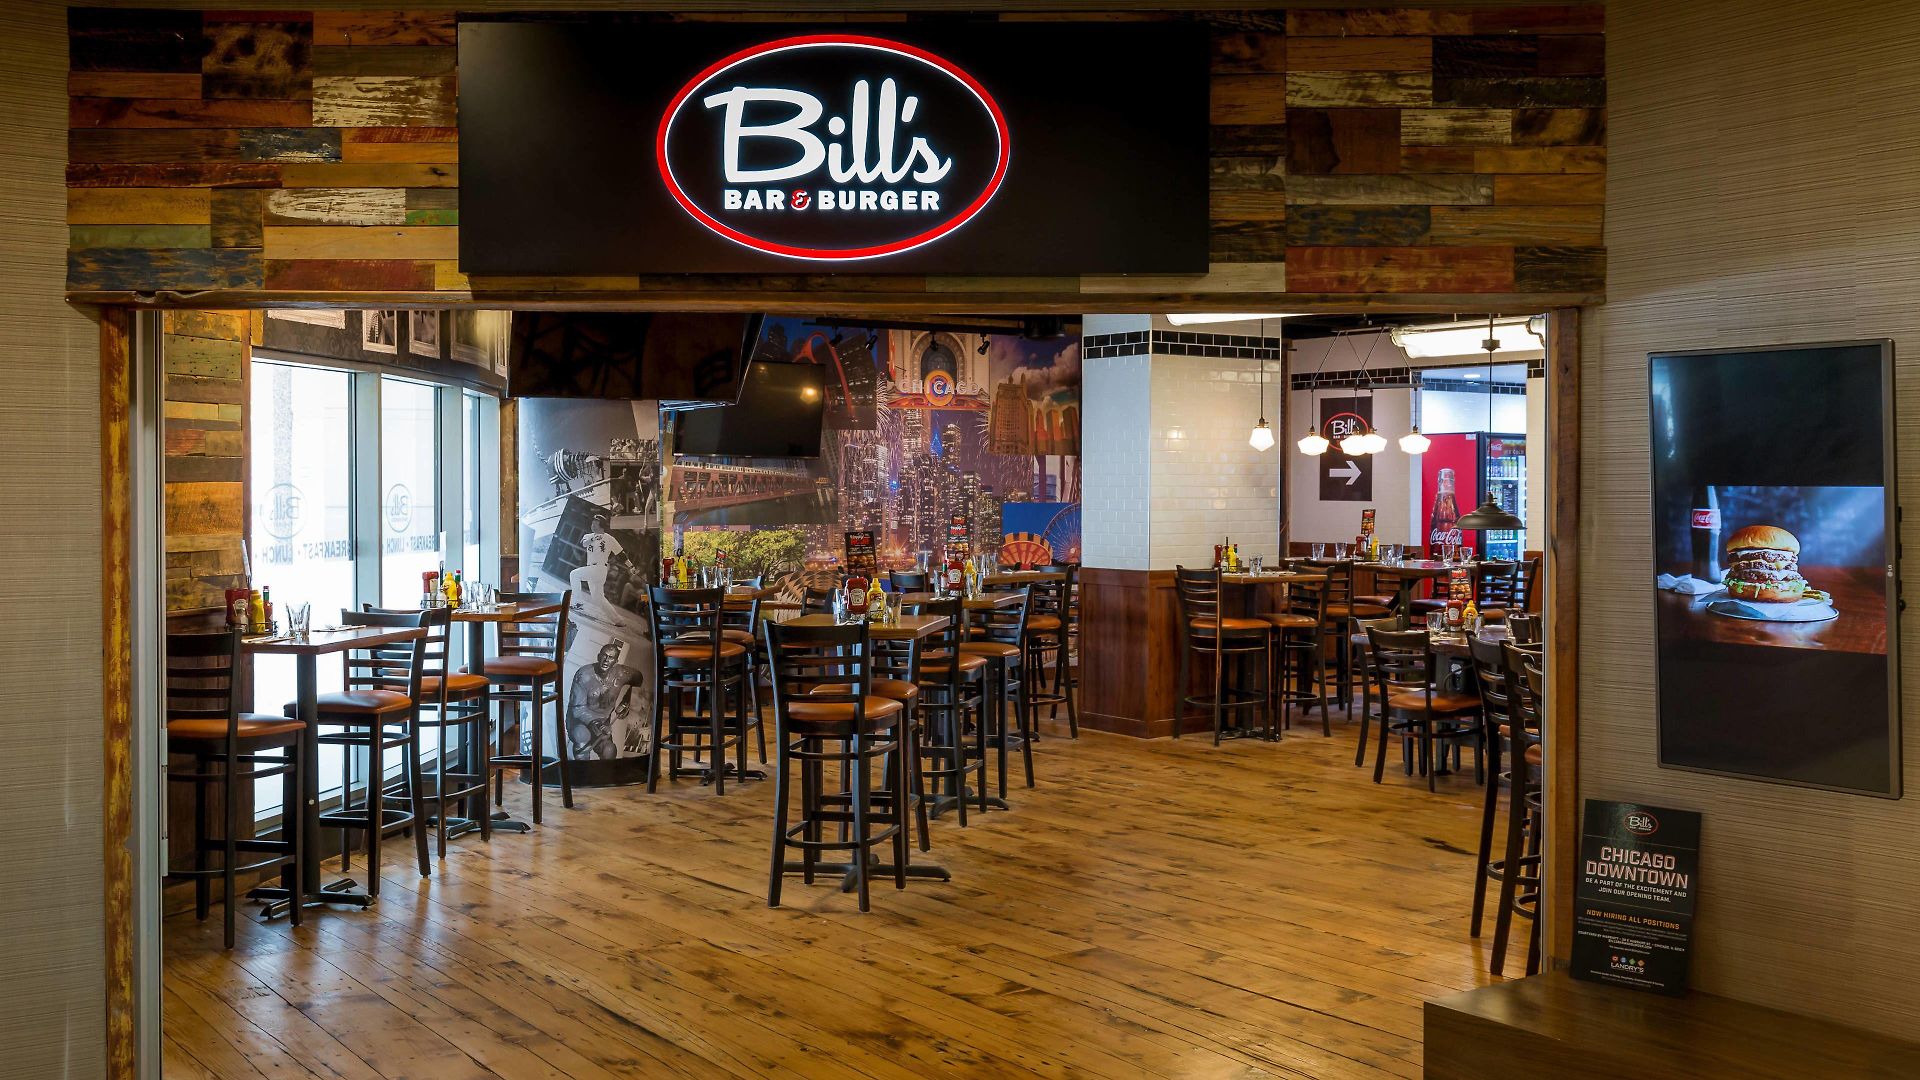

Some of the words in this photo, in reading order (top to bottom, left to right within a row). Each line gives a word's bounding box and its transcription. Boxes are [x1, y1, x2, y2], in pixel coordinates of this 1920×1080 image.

[704, 77, 951, 184] Bill's
[724, 189, 785, 210] BAR
[790, 189, 812, 211] &
[818, 190, 940, 211] BURGER
[900, 379, 979, 395] CHICAGO
[1601, 846, 1675, 870] CHICAGO
[1585, 860, 1689, 889] DOWNTOWN
[1599, 879, 1614, 887] PART
[1636, 885, 1673, 896] EXCITEMENT
[1673, 890, 1687, 898] AND
[1613, 888, 1625, 896] OUR
[1626, 890, 1652, 900] OPENING
[1586, 909, 1601, 917] NOW
[1603, 911, 1627, 921] HIRING
[1628, 916, 1641, 924] ALL
[1643, 918, 1680, 930] POSITIONS
[1610, 962, 1645, 973] LANDRY'S
